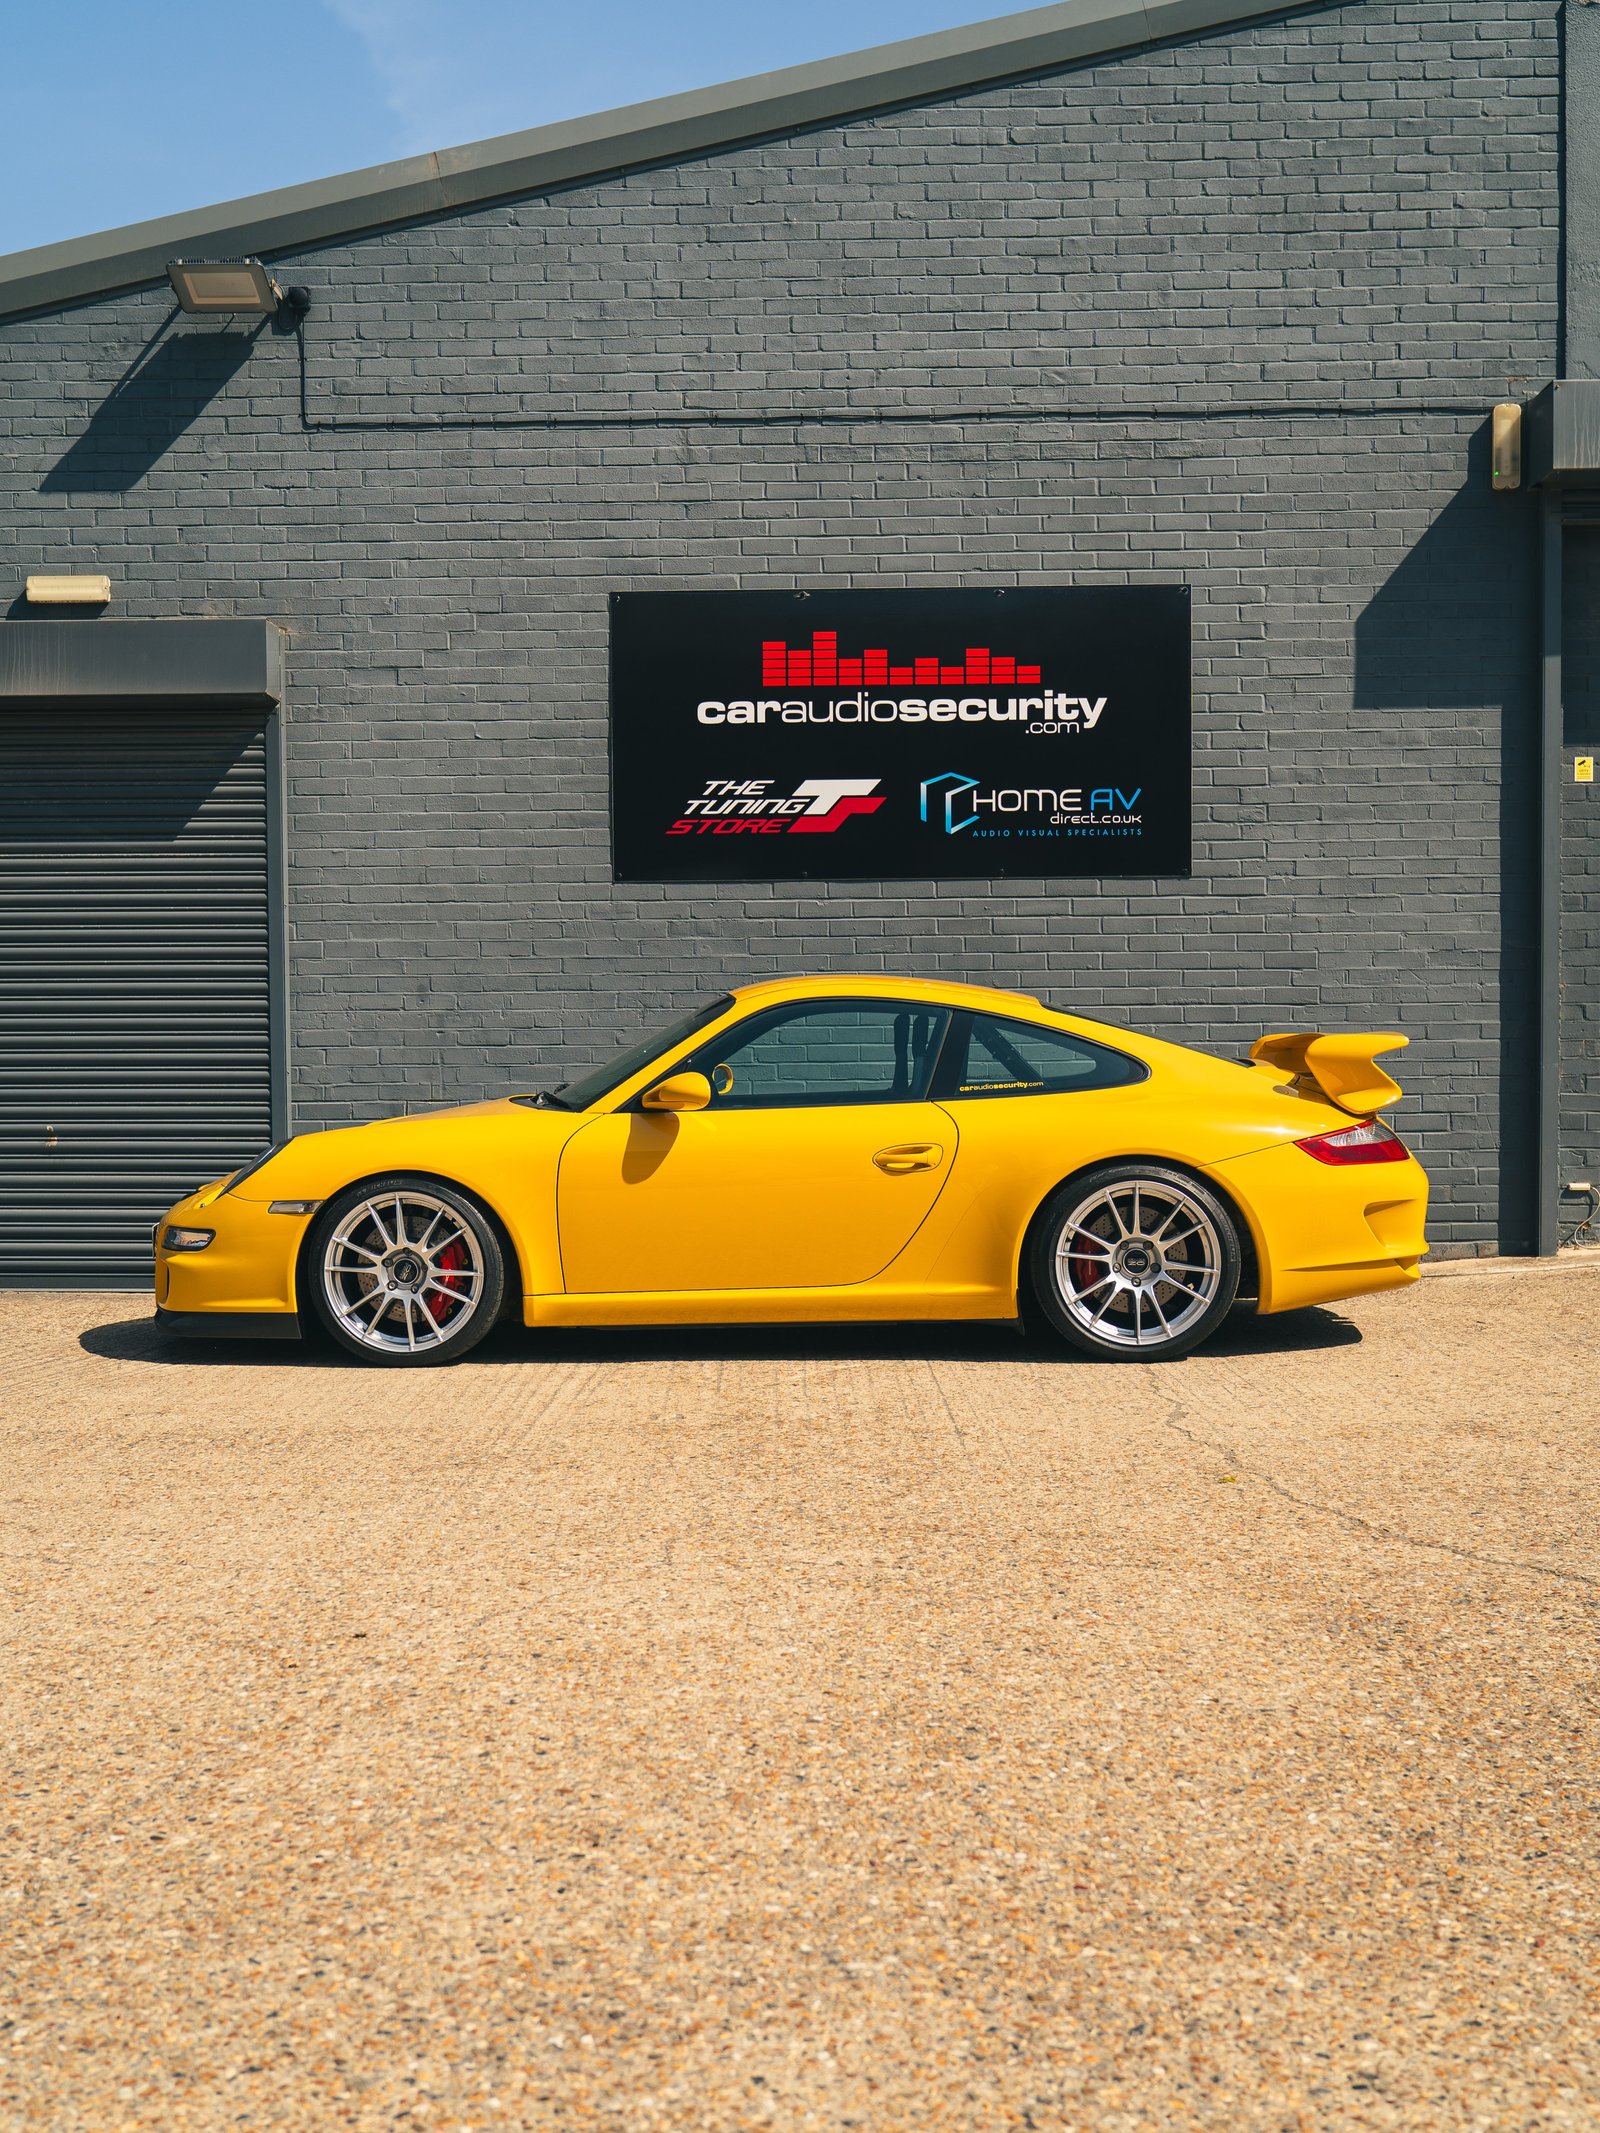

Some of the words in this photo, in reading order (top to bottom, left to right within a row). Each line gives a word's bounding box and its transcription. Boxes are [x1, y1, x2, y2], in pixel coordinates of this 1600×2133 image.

[697, 690, 1107, 728] caraudiosecurity
[1025, 720, 1080, 734] .com
[702, 779, 775, 796] THE
[684, 798, 810, 815] TUNING
[973, 788, 1082, 813] HOME
[1090, 787, 1142, 811] AV
[665, 818, 791, 835] STORE
[1050, 812, 1142, 825] direct.co.uk
[972, 829, 1011, 838] AUDIO
[1017, 828, 1060, 837] VISUAL
[1067, 828, 1142, 837] SPECIALISTS
[960, 1081, 1044, 1092] caraudiosecurity.com
